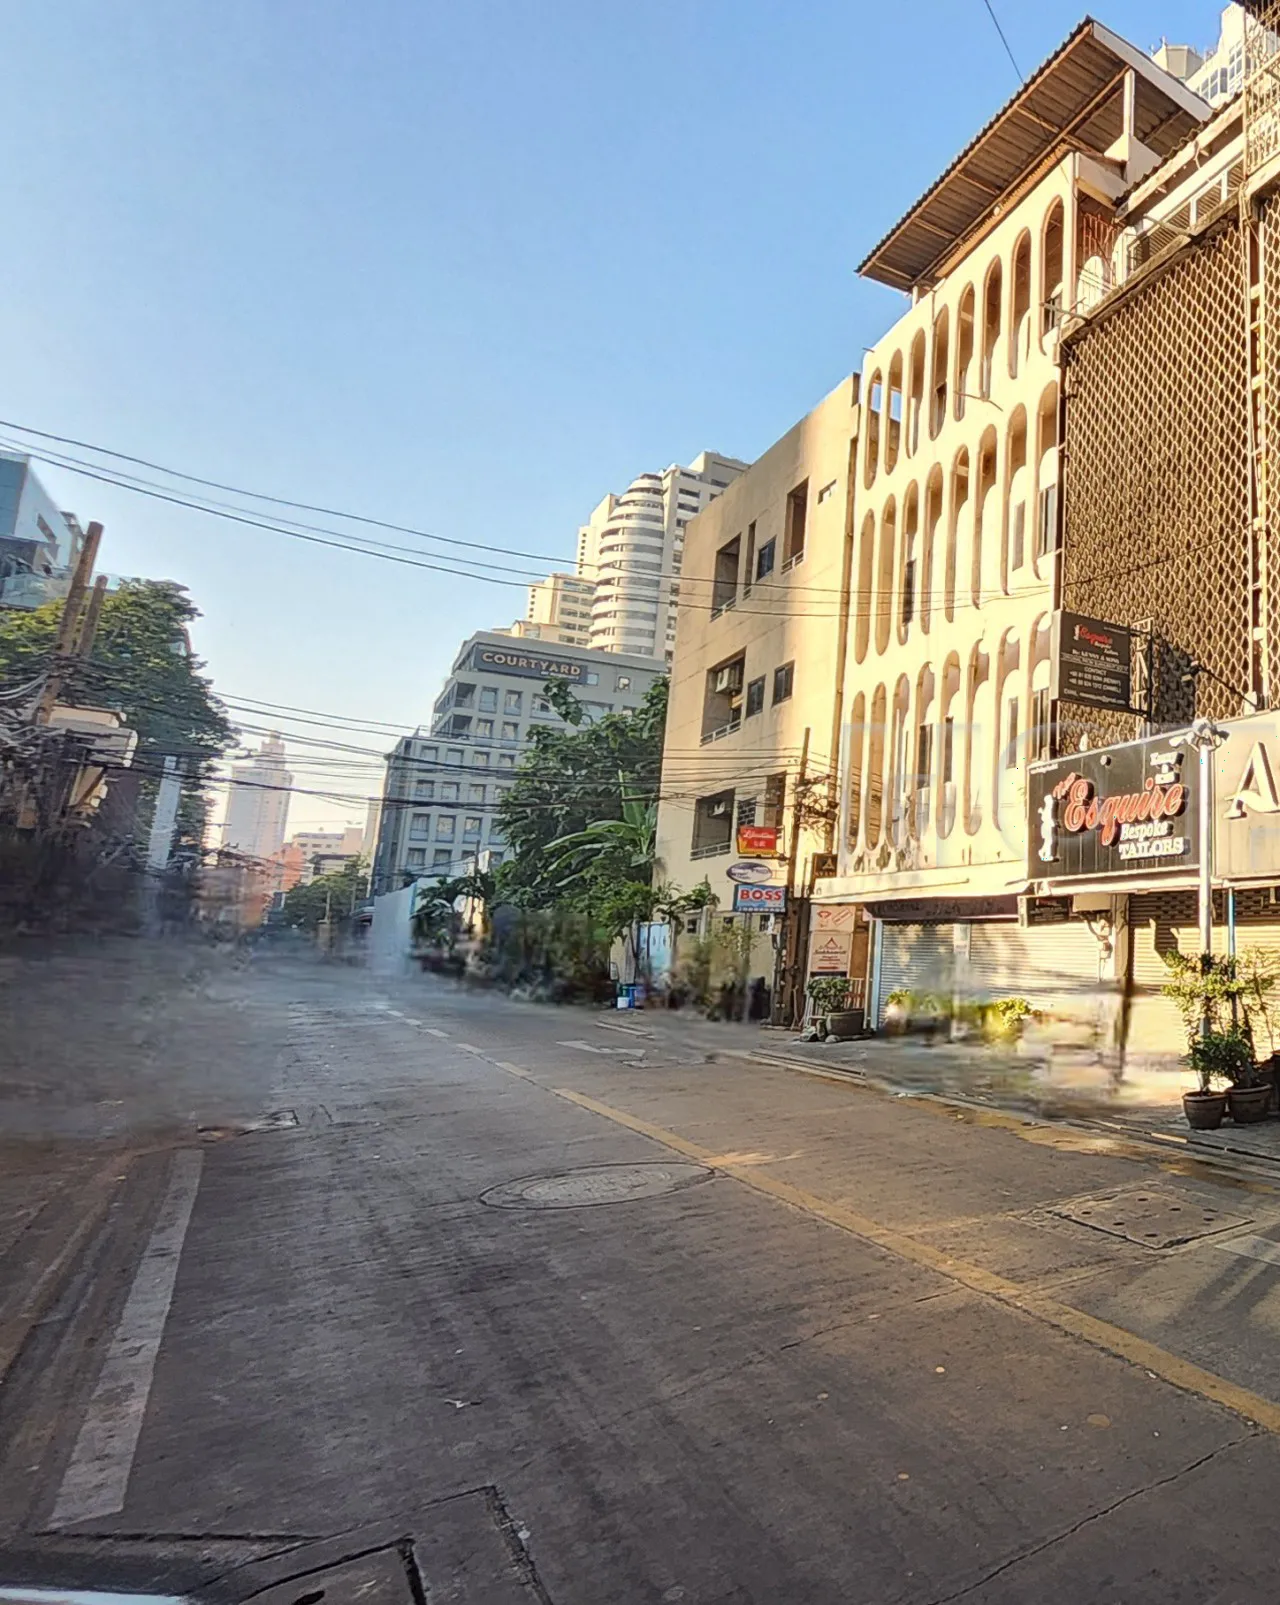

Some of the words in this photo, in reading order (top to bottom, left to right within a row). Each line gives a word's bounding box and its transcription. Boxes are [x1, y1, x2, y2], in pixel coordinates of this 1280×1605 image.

[482, 651, 581, 676] COURTYARD
[1064, 777, 1184, 847] Esquire
[1120, 819, 1169, 841] Bespoke
[1118, 837, 1185, 861] TAILORS
[739, 888, 783, 901] BOSS
